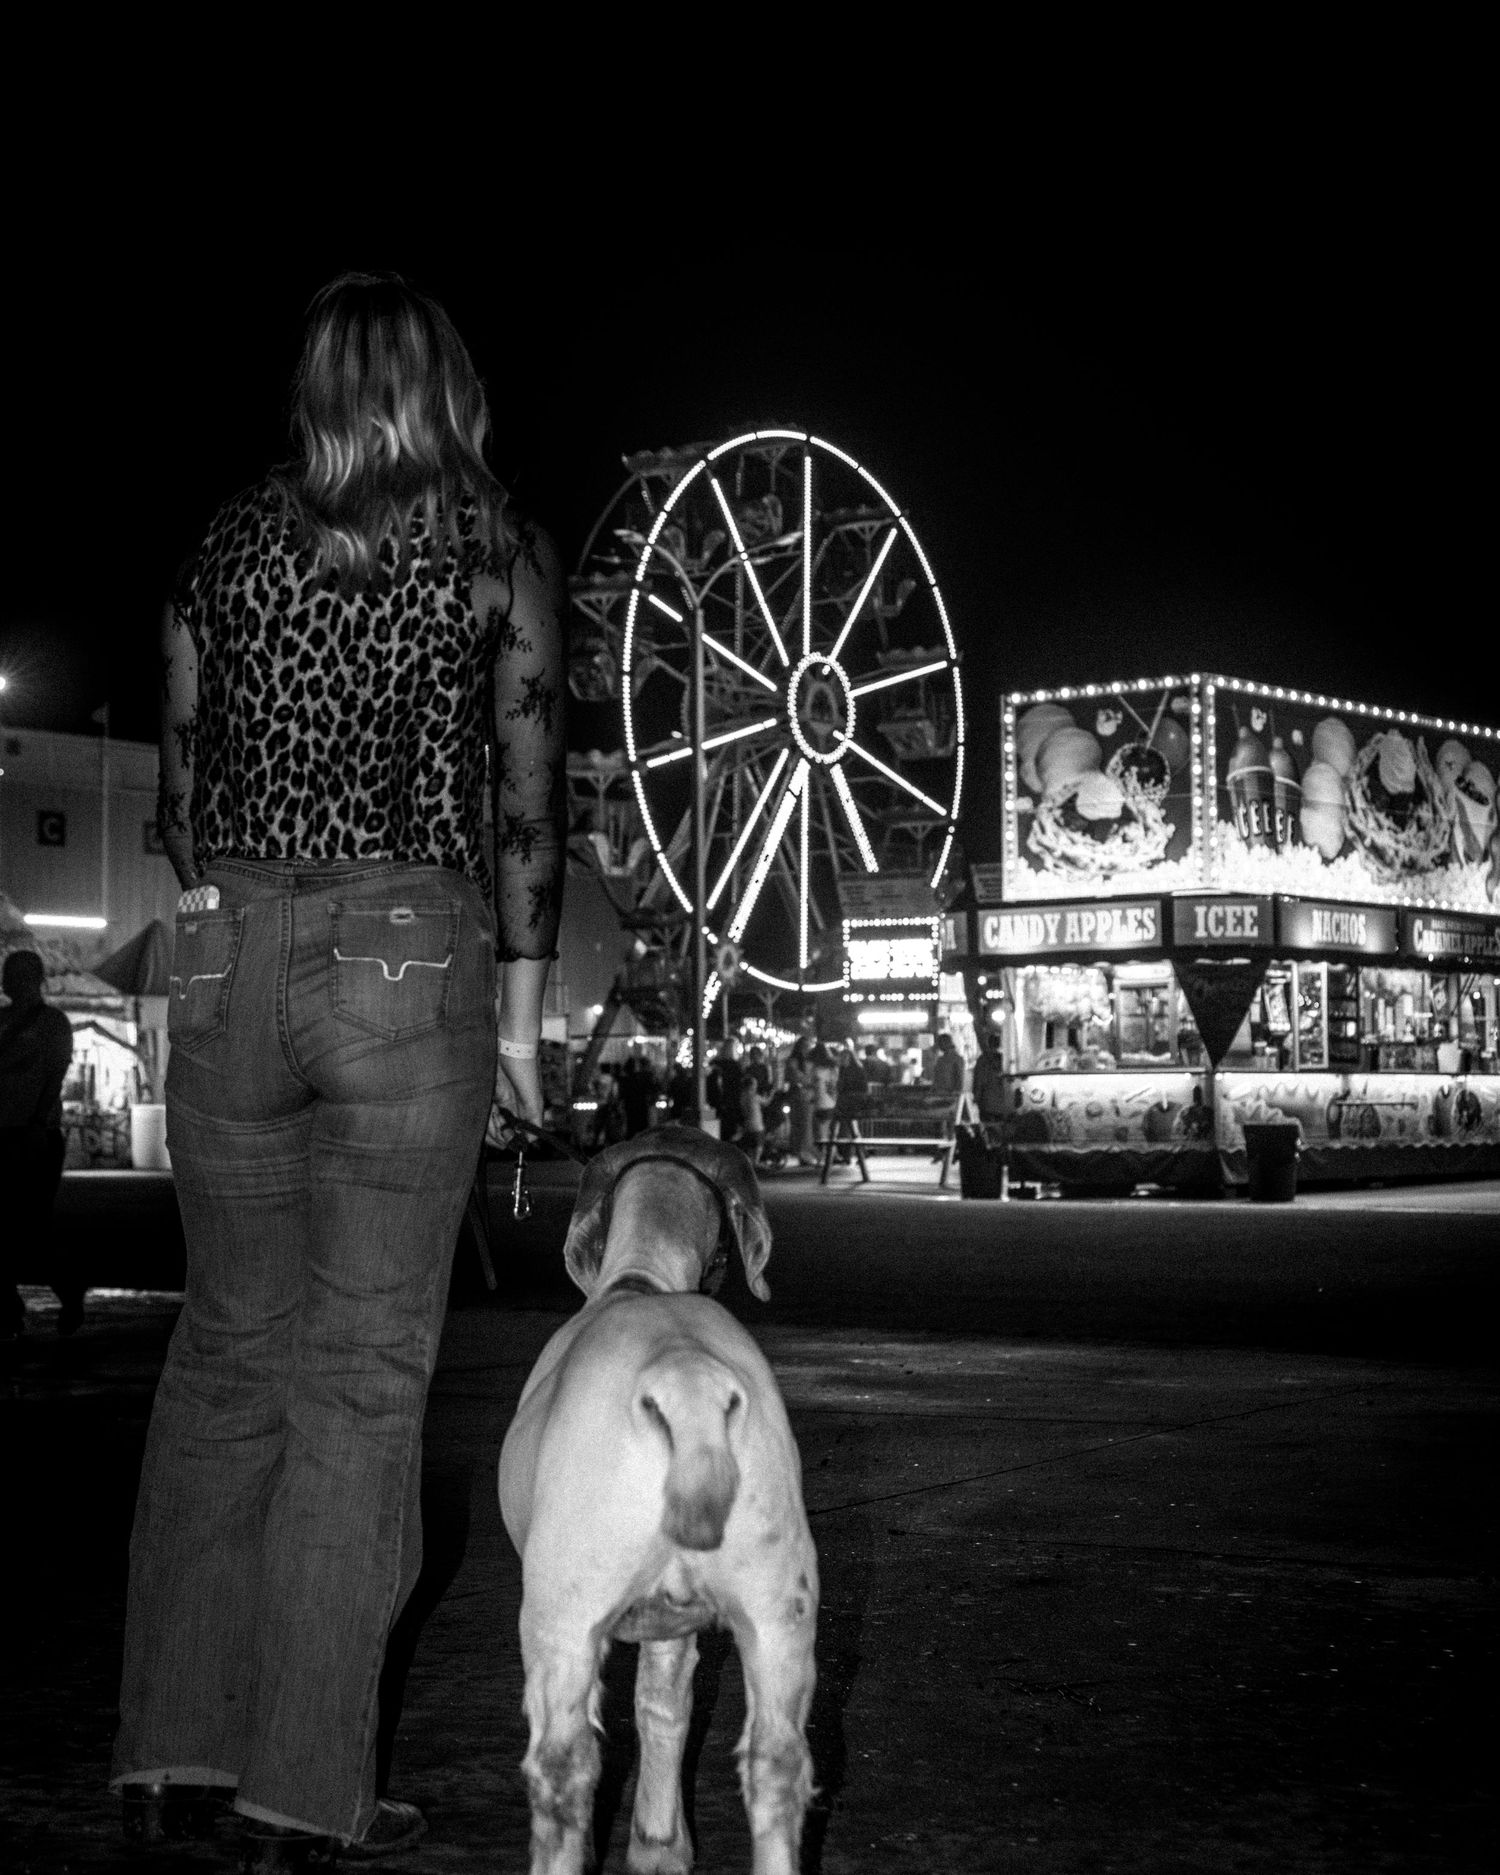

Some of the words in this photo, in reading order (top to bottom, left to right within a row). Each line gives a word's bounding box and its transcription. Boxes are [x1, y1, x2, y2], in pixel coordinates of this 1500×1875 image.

[983, 912, 1061, 948] CANDY
[1064, 907, 1157, 944] APPLES
[1194, 905, 1259, 938] ICEE
[1312, 909, 1367, 946] NACHOS
[1413, 918, 1463, 953] CARAMEL
